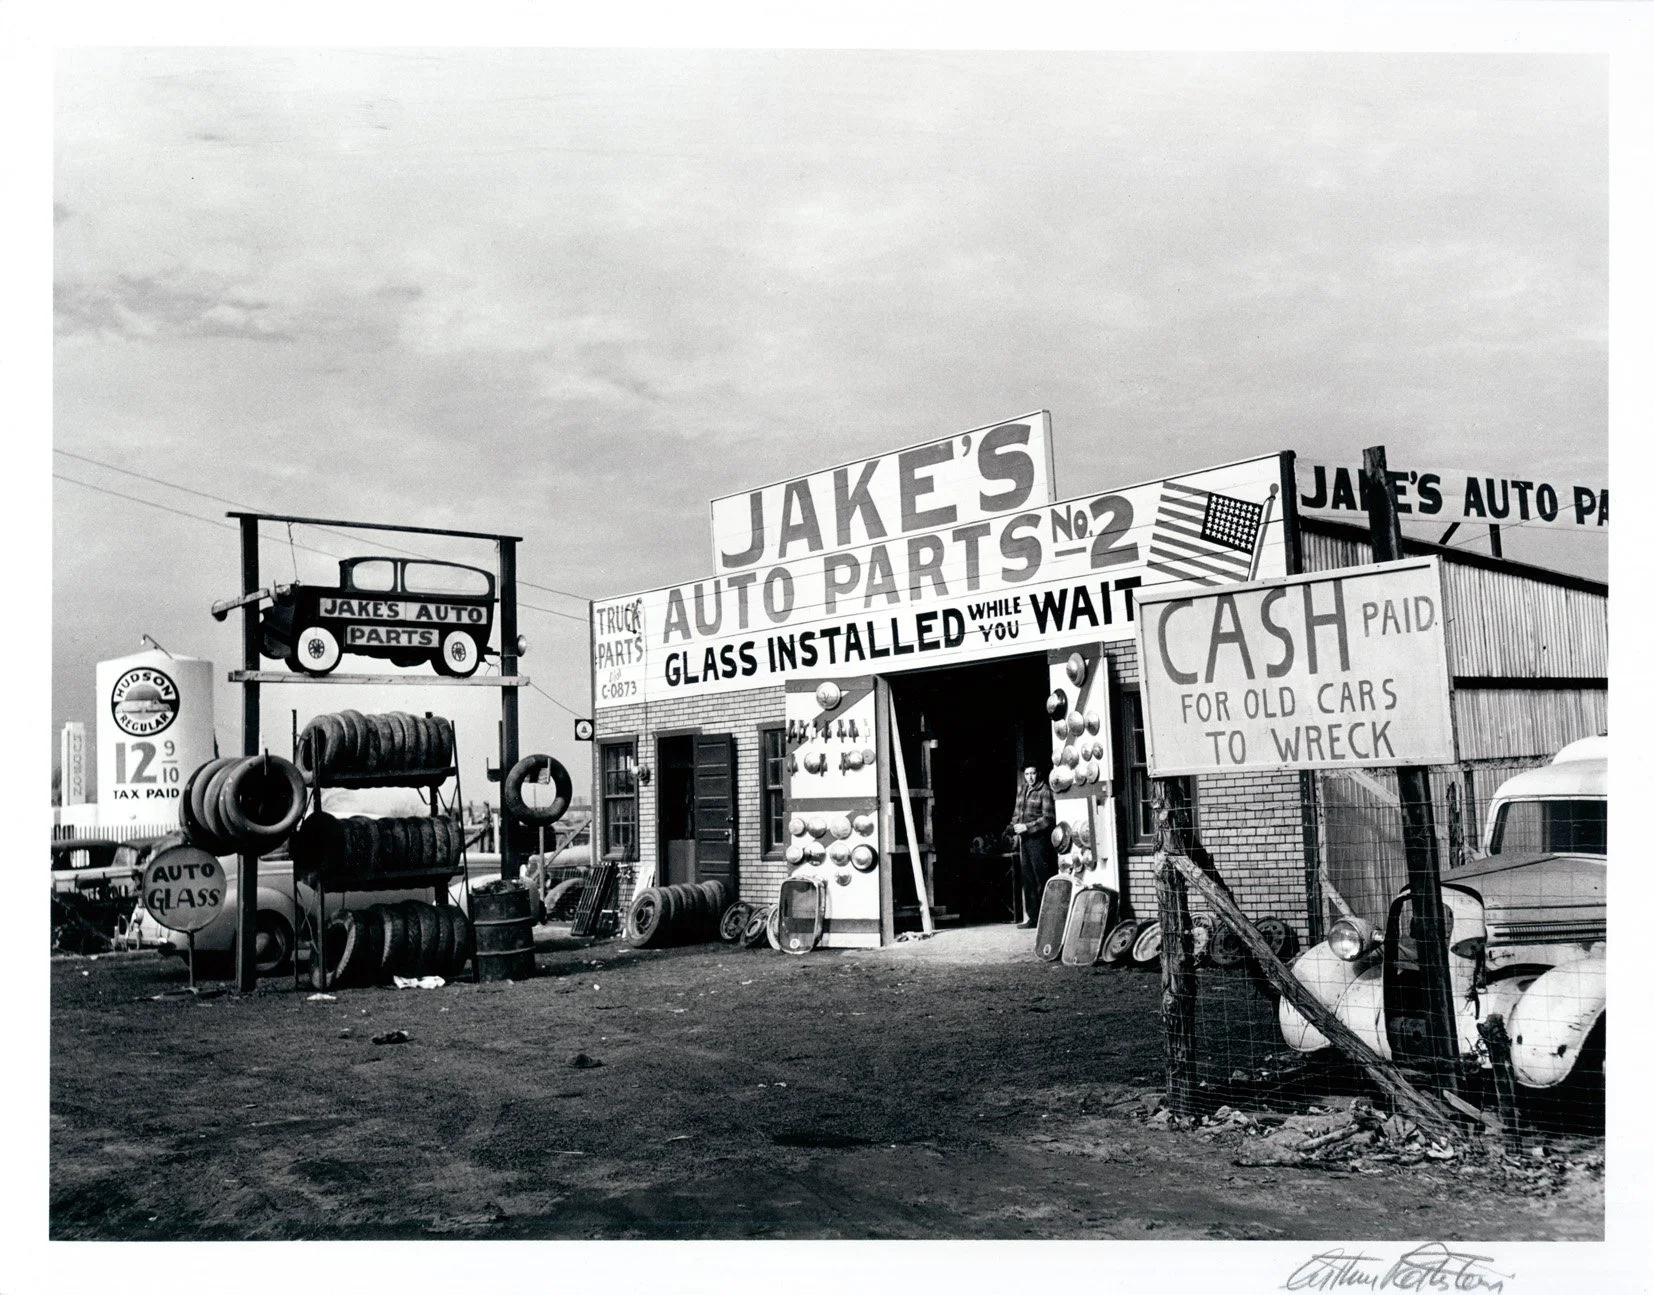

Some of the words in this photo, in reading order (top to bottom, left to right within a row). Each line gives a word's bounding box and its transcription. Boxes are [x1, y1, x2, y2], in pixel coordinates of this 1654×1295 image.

[721, 423, 1035, 569] JAKE'S
[1300, 466, 1442, 514] JAE'S
[1463, 476, 1558, 522] AUTO
[663, 566, 796, 644] AUTO
[823, 513, 1041, 615] PARTS
[1089, 495, 1139, 570] 2
[324, 600, 401, 619] JAKE'S
[415, 605, 483, 622] AUTO
[596, 601, 641, 635] TRUCK
[349, 627, 434, 645] PARTS
[664, 641, 758, 687] GLASS
[766, 606, 966, 673] INSTALLED
[966, 596, 1021, 621] WHILE
[1027, 576, 1141, 634] WAIT
[977, 620, 1018, 643] YOU
[1158, 579, 1351, 686] CASH
[1362, 596, 1435, 637] PAID
[597, 635, 644, 670] PARTS
[117, 672, 173, 698] HUDSON
[1181, 691, 1231, 723] FOR
[1244, 688, 1296, 720] OLD
[1317, 679, 1398, 713] CARS
[120, 712, 169, 732] REGULAR
[1205, 730, 1246, 764] TO
[1270, 720, 1396, 763] WRECK
[115, 742, 157, 784] 12
[113, 789, 140, 800] TAX
[146, 787, 180, 799] PAID
[152, 863, 215, 883] AUTO
[147, 888, 221, 916] GLASS
